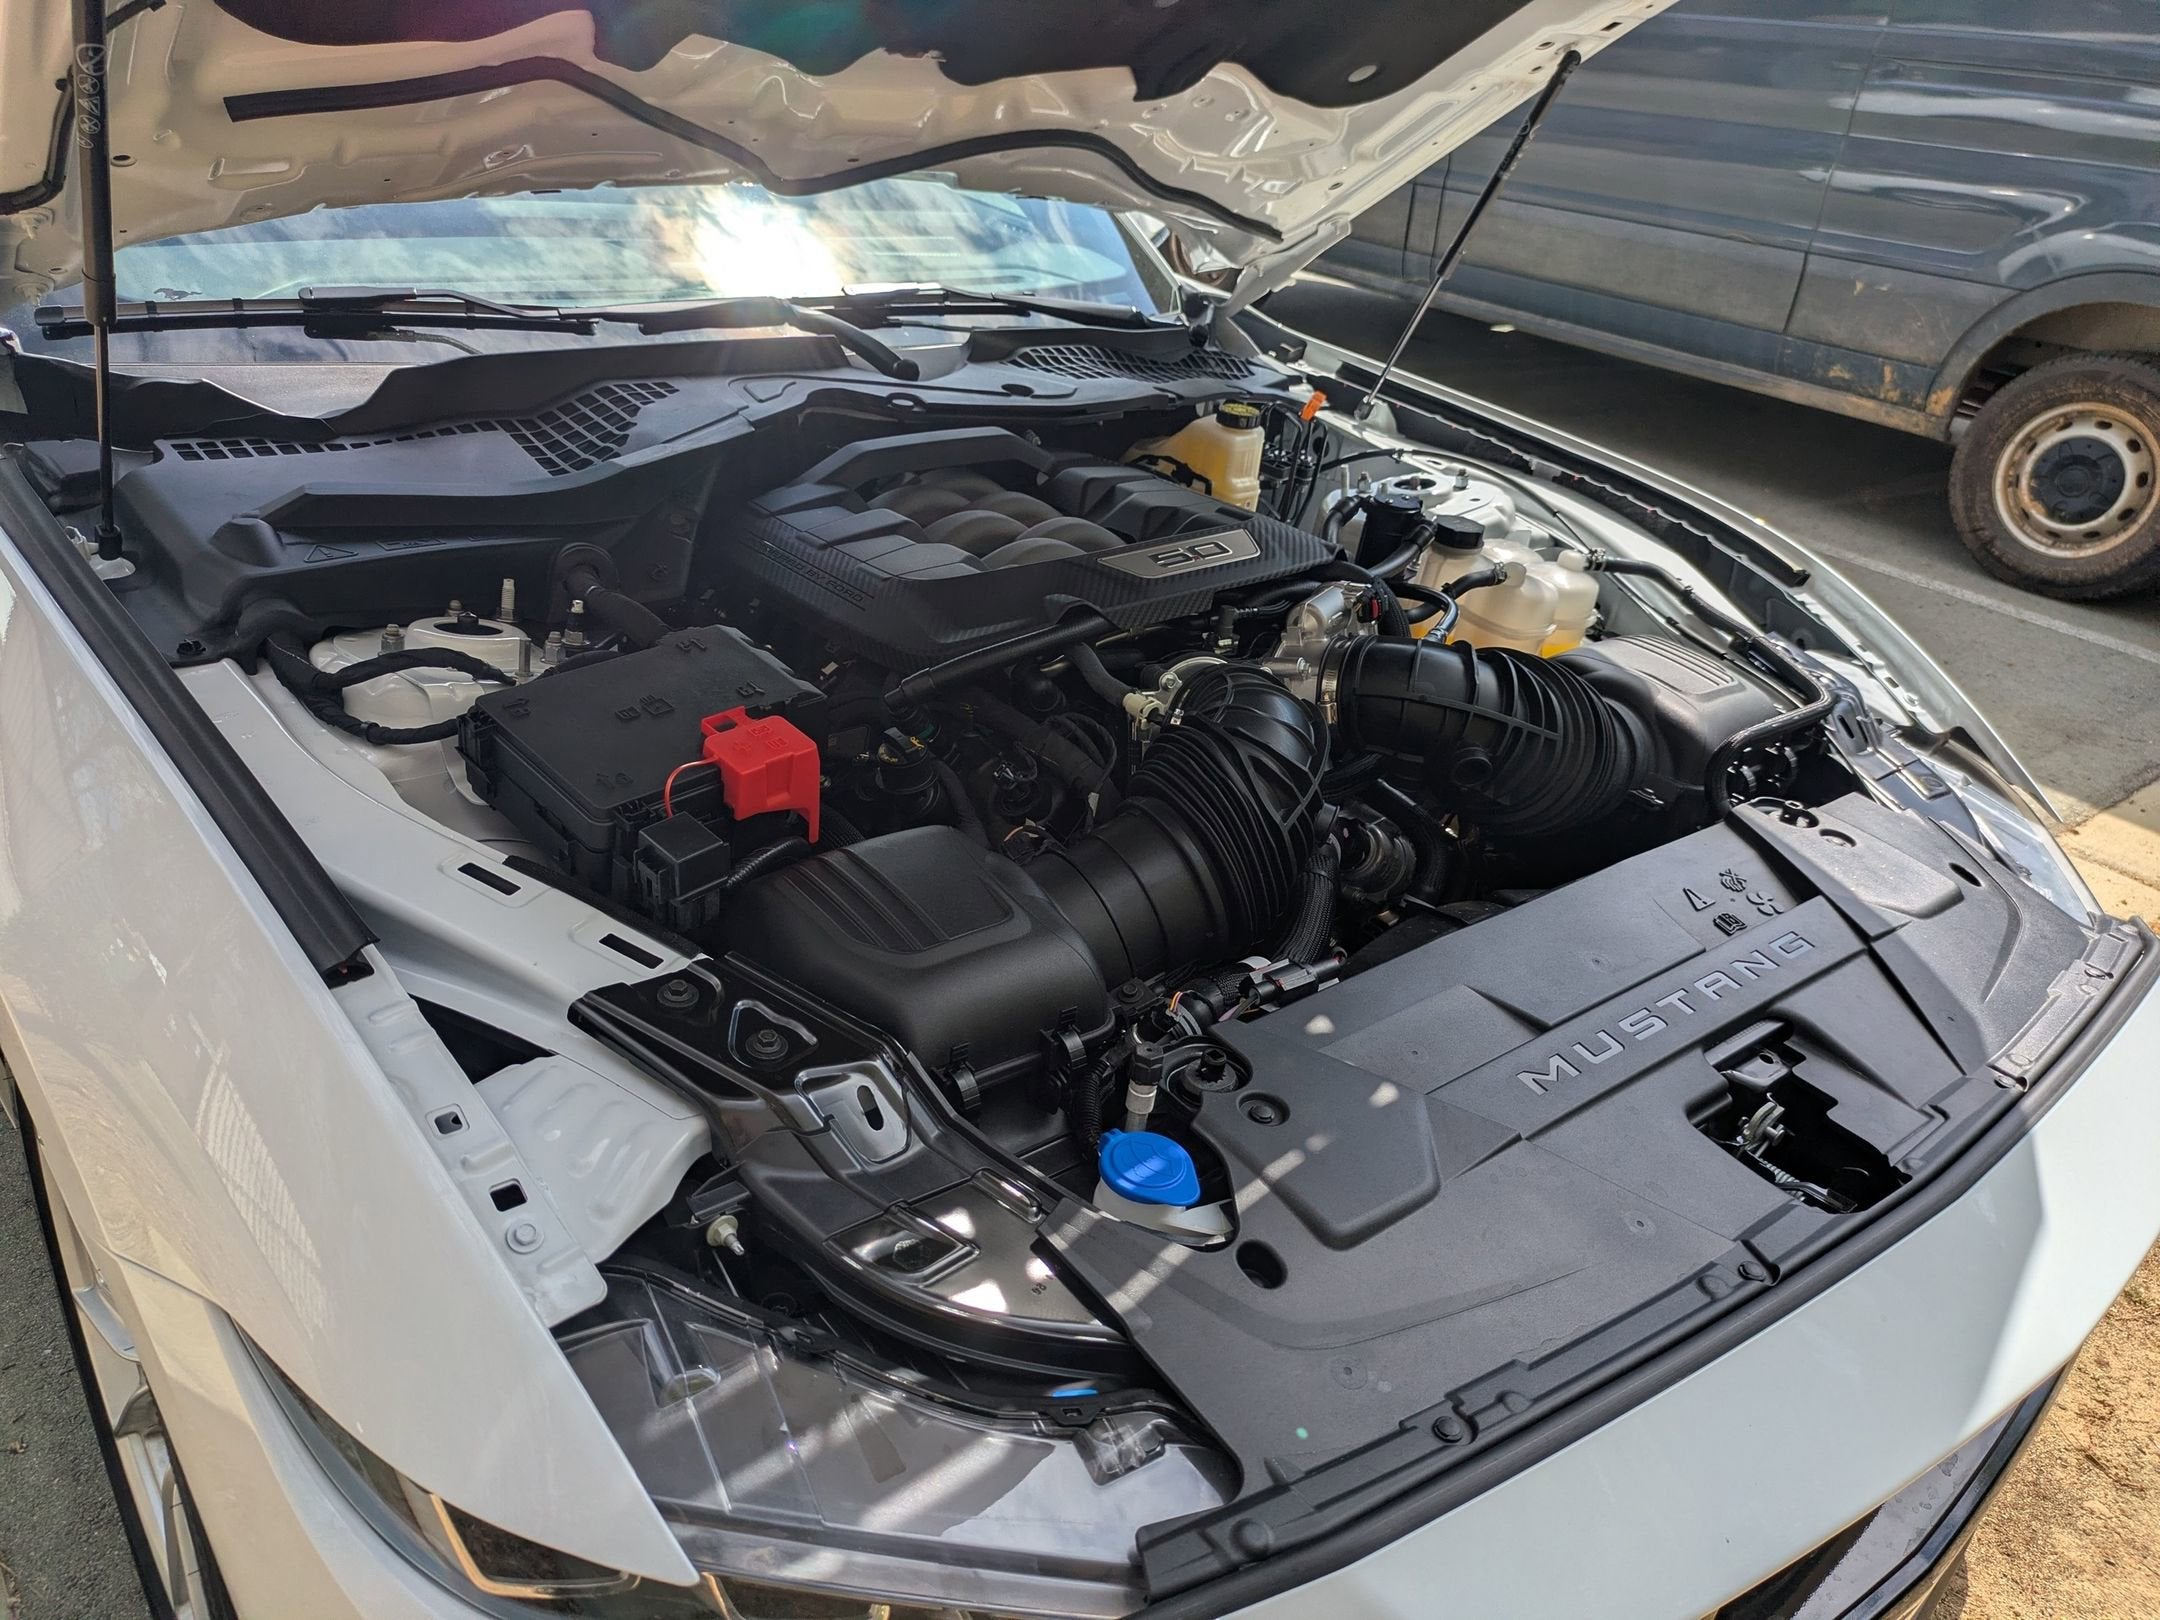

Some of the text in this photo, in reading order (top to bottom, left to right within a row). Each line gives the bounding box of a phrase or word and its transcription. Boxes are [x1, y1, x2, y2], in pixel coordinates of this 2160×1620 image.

[1148, 541, 1233, 568] 5.0
[805, 568, 826, 581] BY
[825, 580, 864, 602] FORD
[1515, 930, 1816, 1096] MUSTANG
